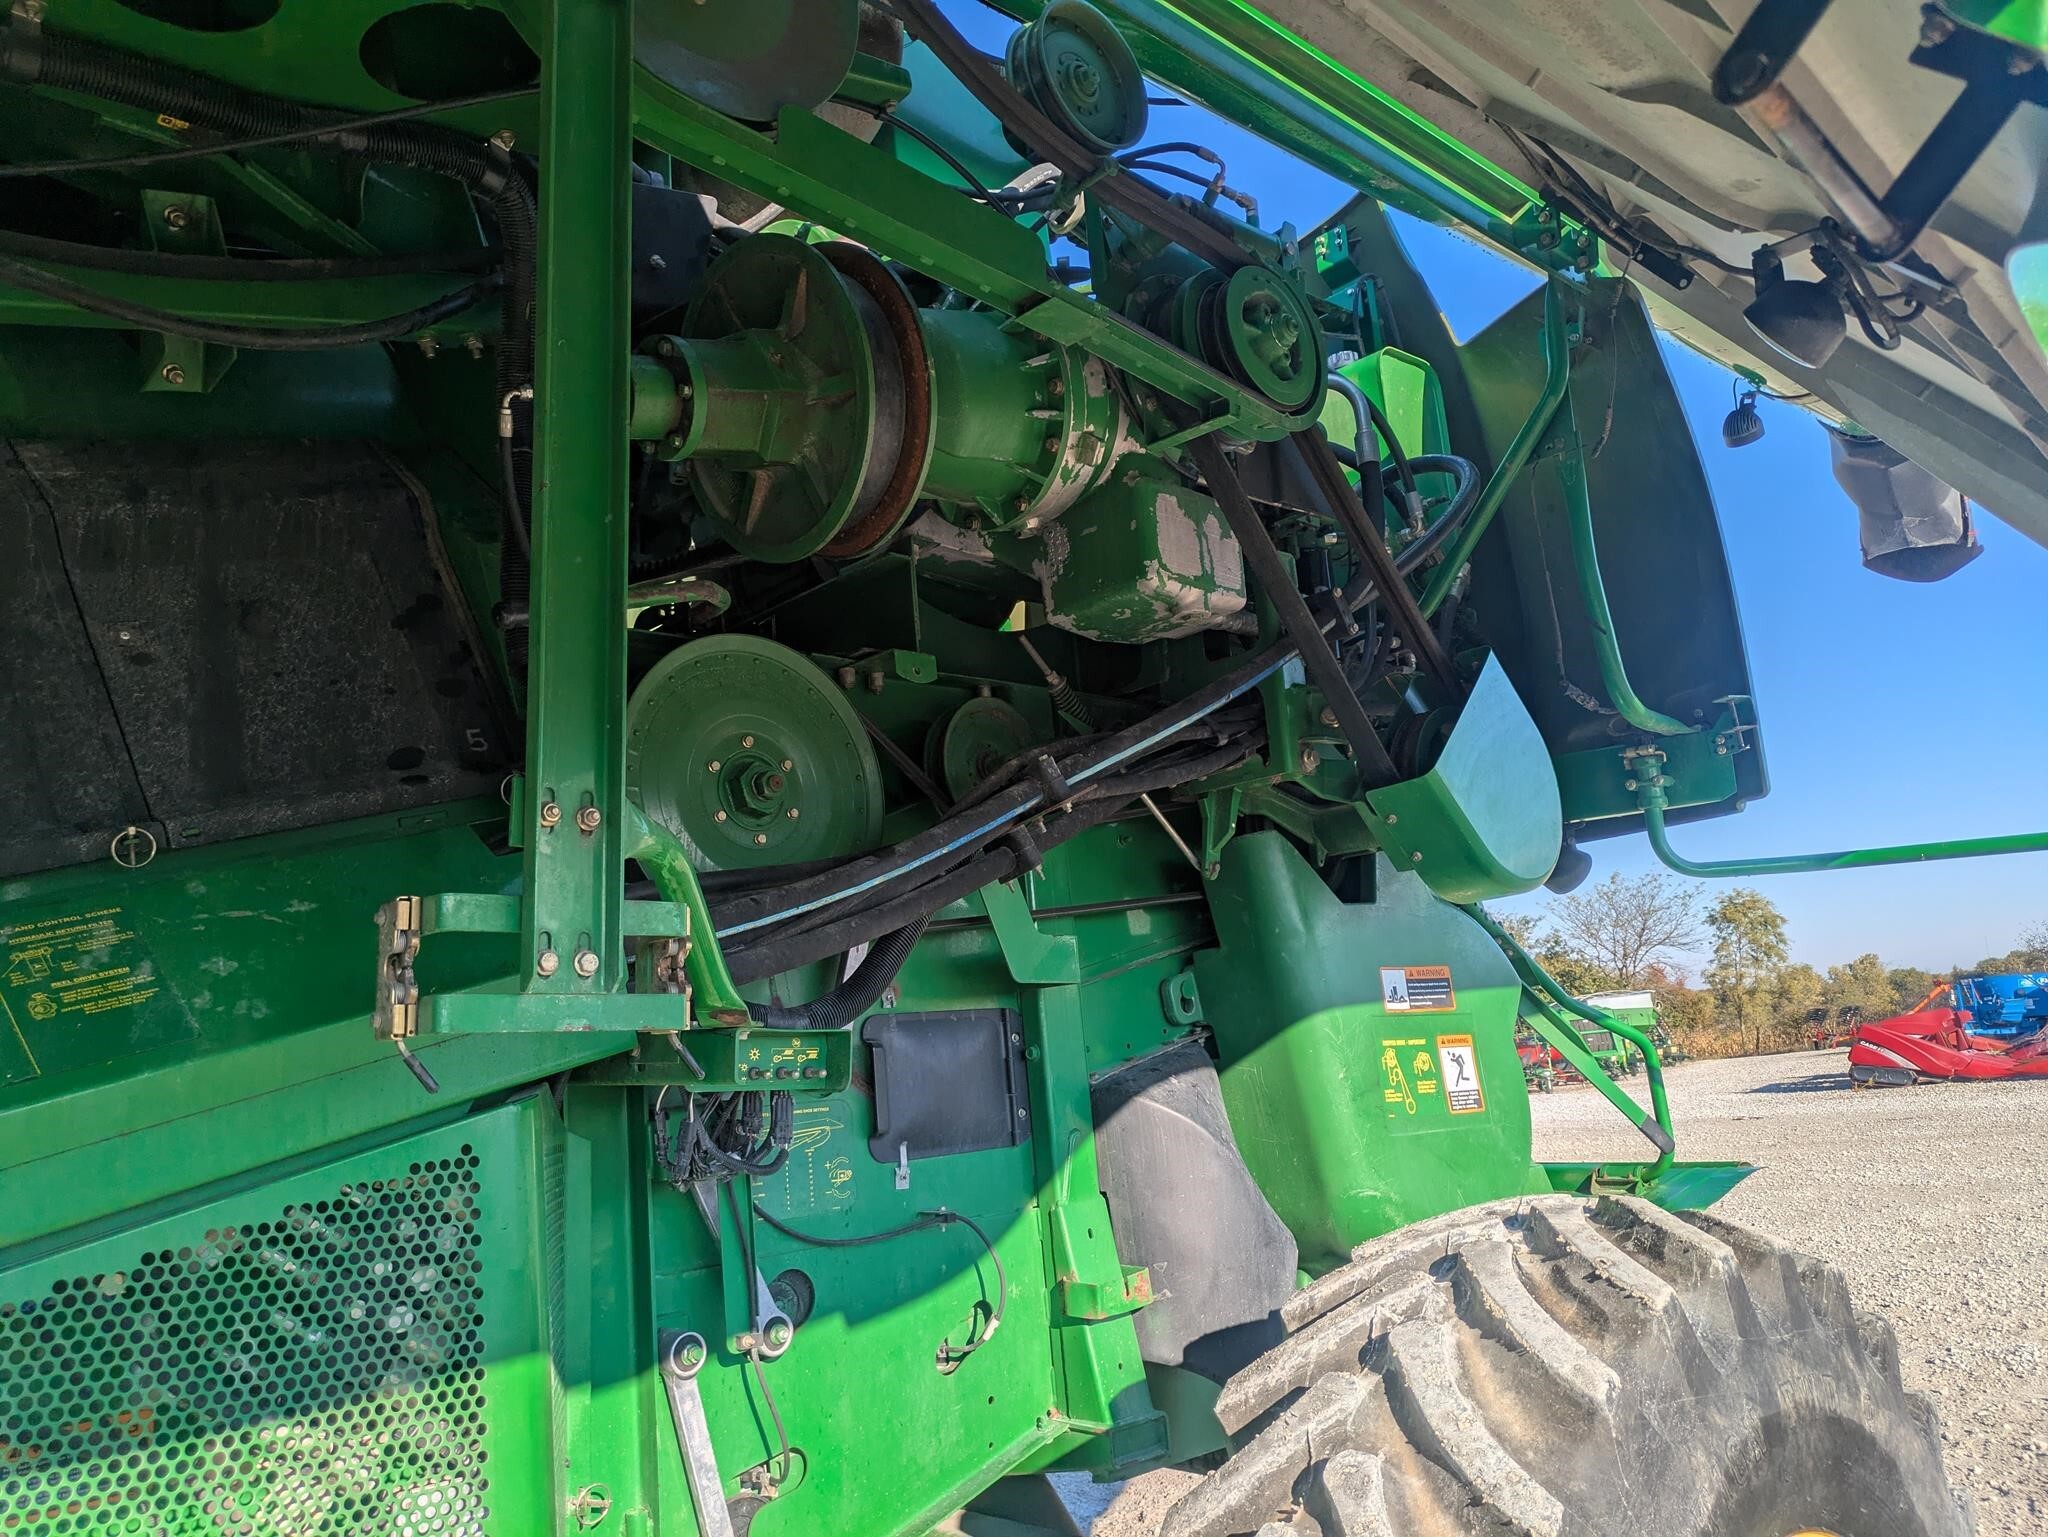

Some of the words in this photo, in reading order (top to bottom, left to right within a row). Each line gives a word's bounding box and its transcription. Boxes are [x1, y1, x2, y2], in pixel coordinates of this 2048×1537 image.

[15, 923, 35, 932] AND
[37, 915, 83, 928] CONTROL
[85, 907, 122, 918] SCHEME
[9, 930, 55, 944] HYDRAULIC
[55, 925, 87, 936] RETURN
[98, 966, 130, 979] SYSTEM
[1416, 968, 1445, 977] WARNING
[1860, 1040, 1880, 1051] CASE
